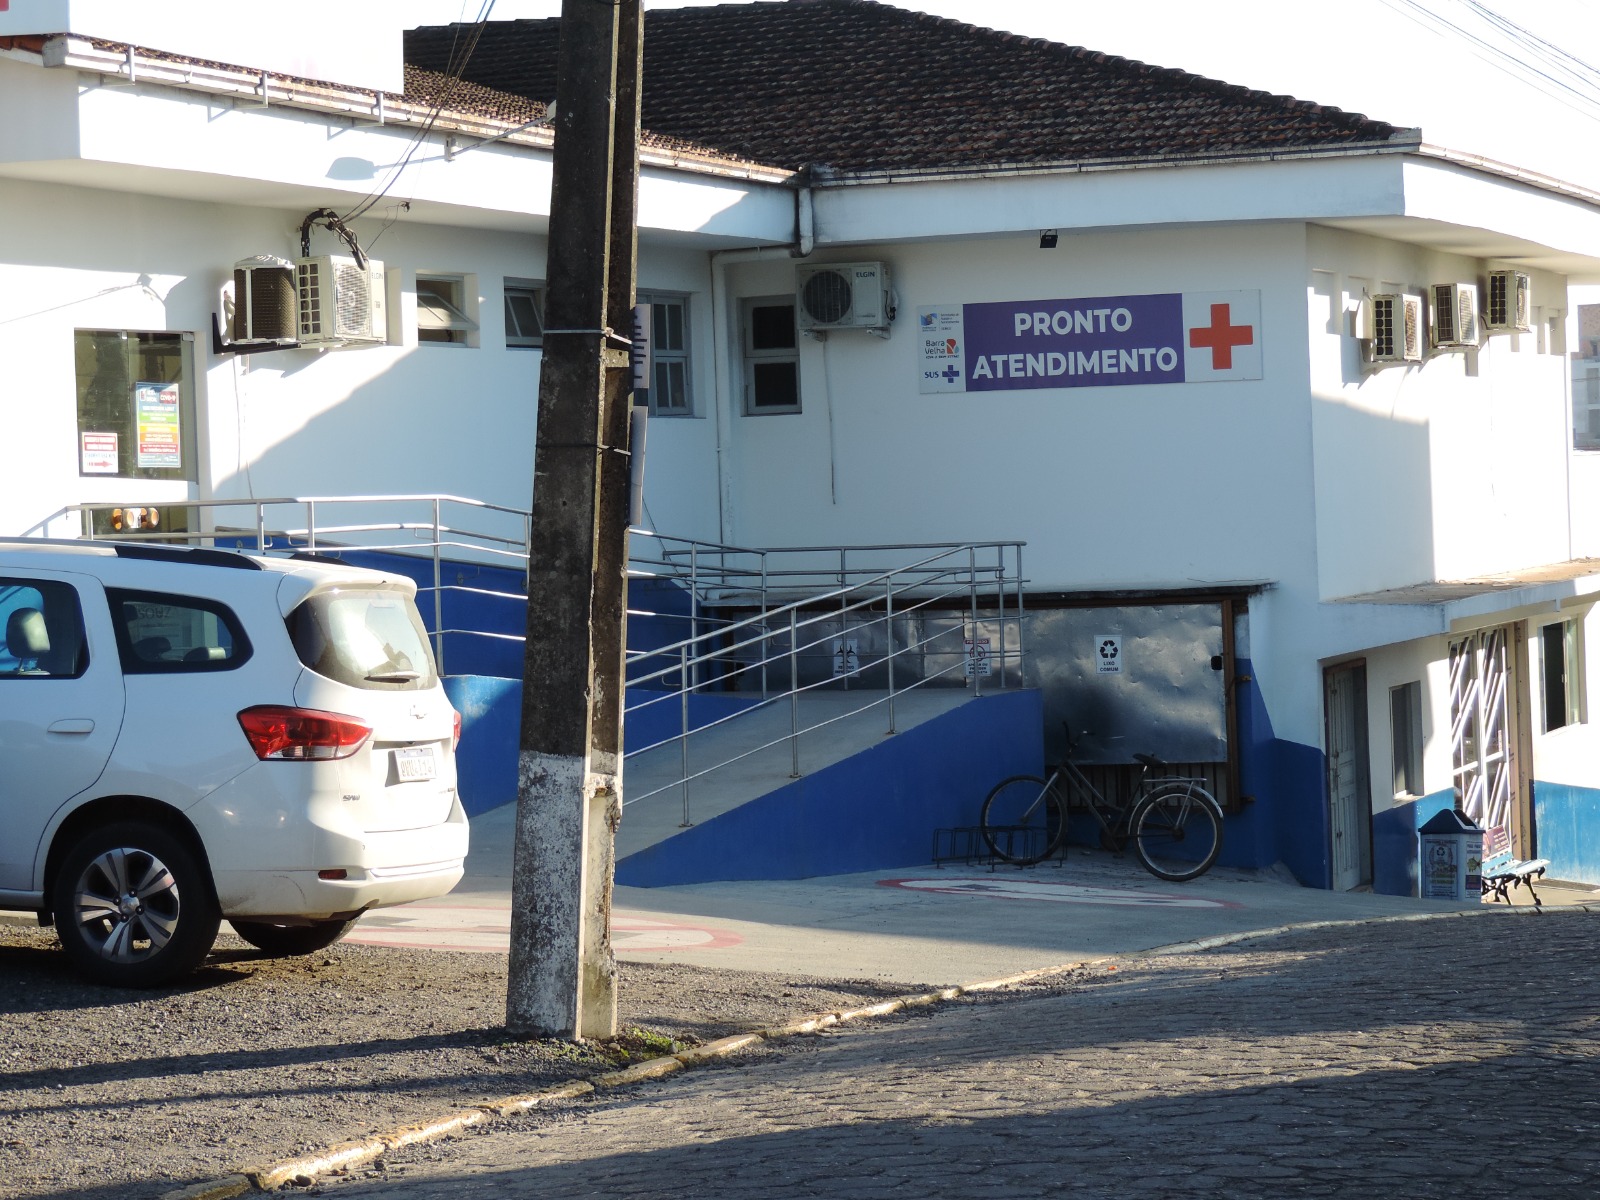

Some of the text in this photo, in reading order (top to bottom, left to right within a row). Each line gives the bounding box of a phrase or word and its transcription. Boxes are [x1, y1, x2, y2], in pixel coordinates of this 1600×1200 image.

[1013, 307, 1133, 337] PRONTO
[924, 346, 946, 355] Velha
[971, 346, 1179, 380] ATENDIMENTO
[924, 371, 940, 379] SUS
